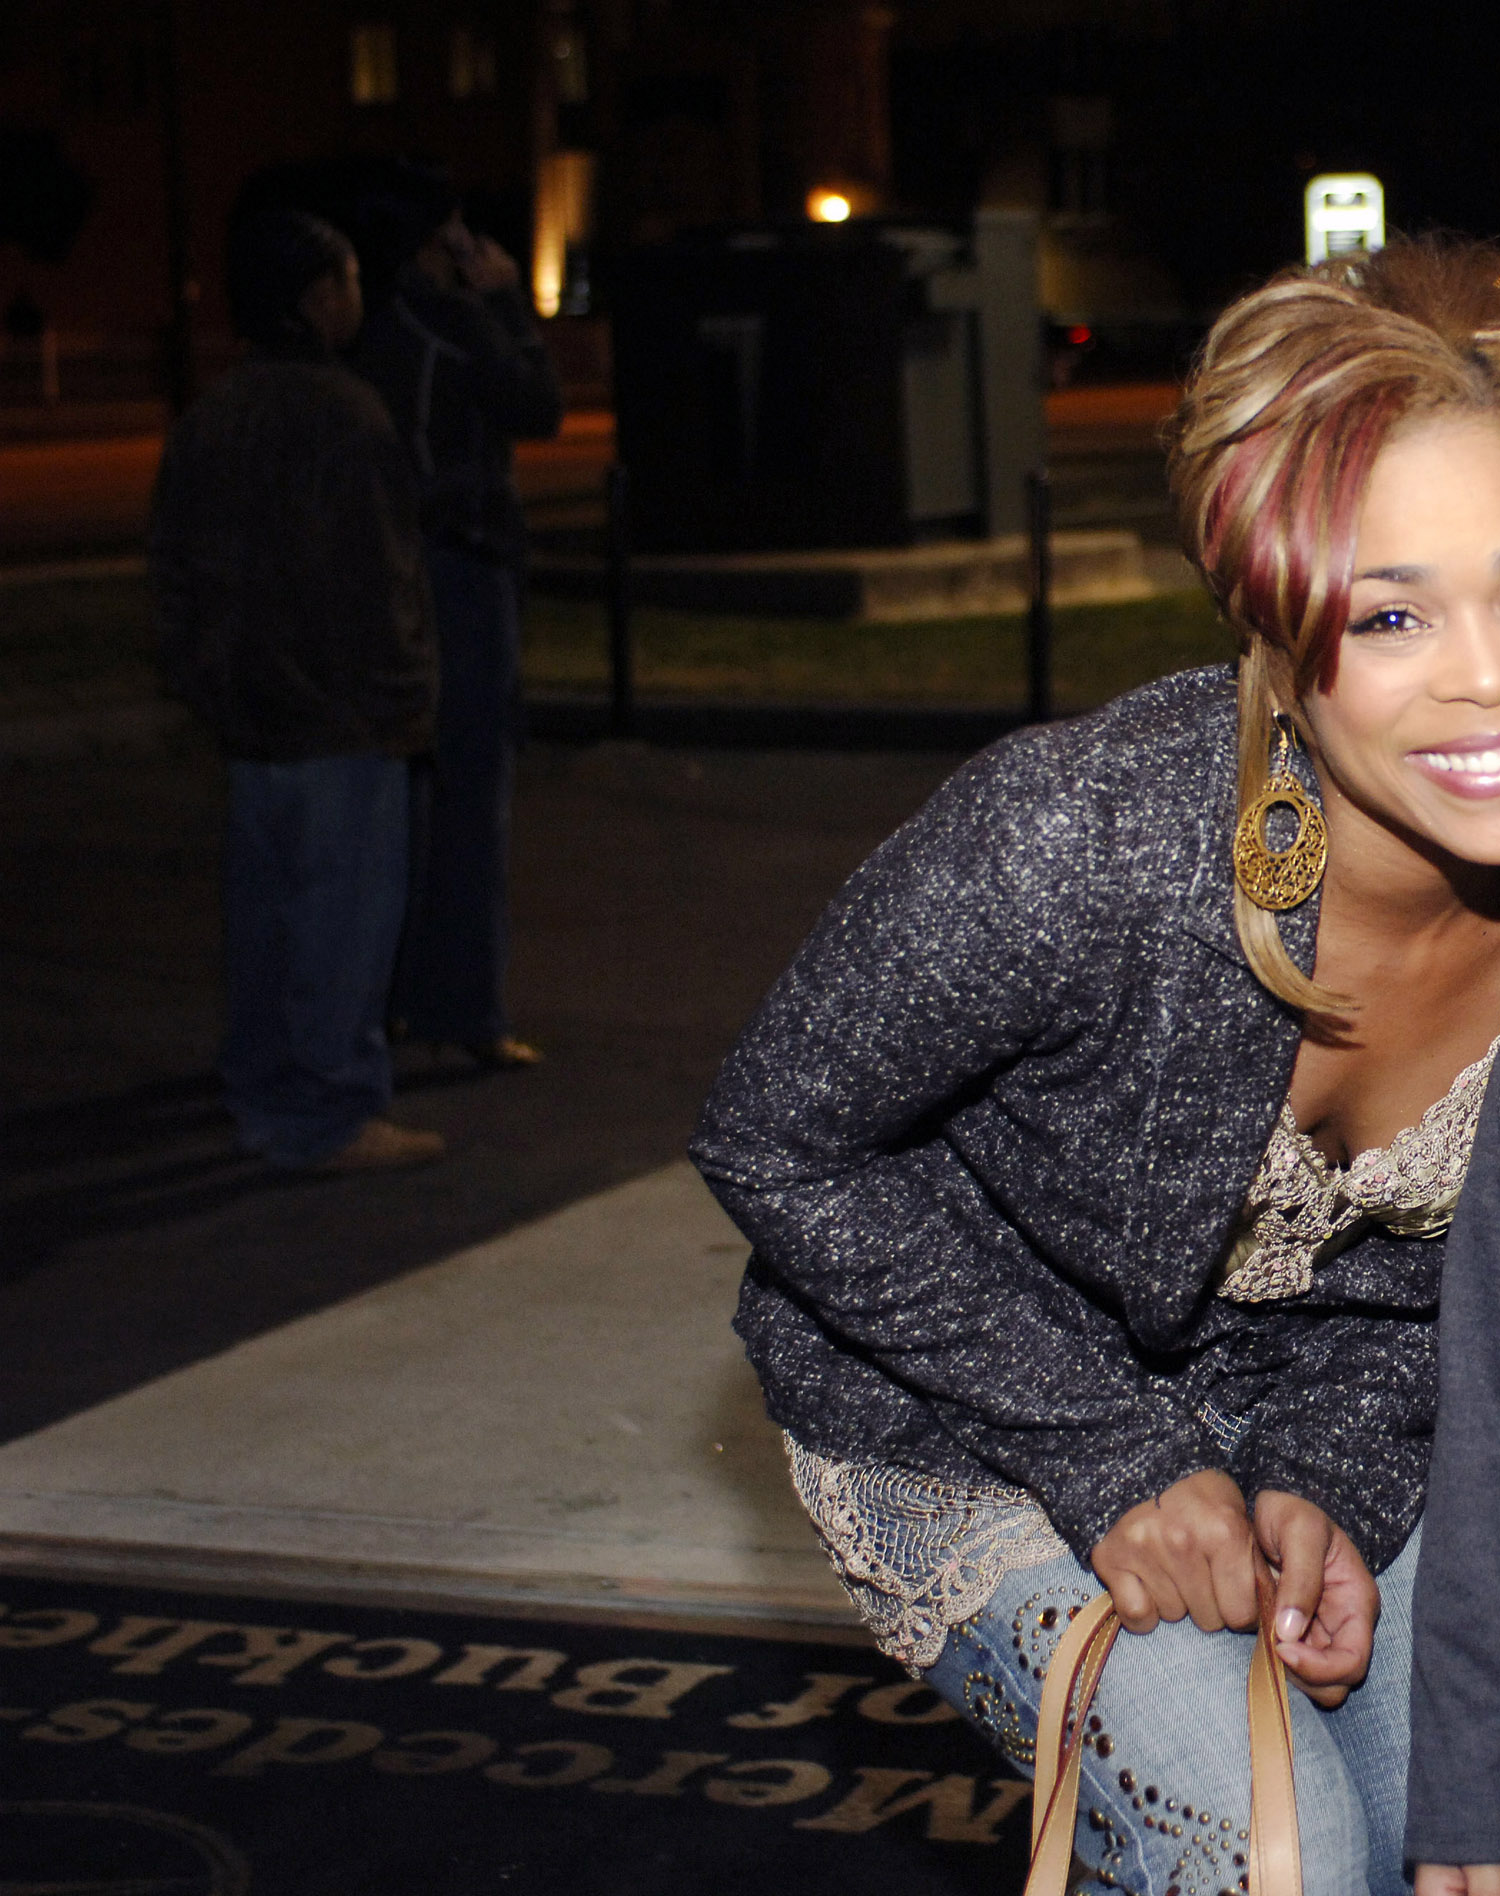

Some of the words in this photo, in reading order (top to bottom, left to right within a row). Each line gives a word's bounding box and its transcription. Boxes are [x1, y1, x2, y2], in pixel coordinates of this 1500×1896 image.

[0, 1605, 737, 1720] Buckhe
[726, 1673, 963, 1729] of
[0, 1699, 1034, 1844] Mercedes-
